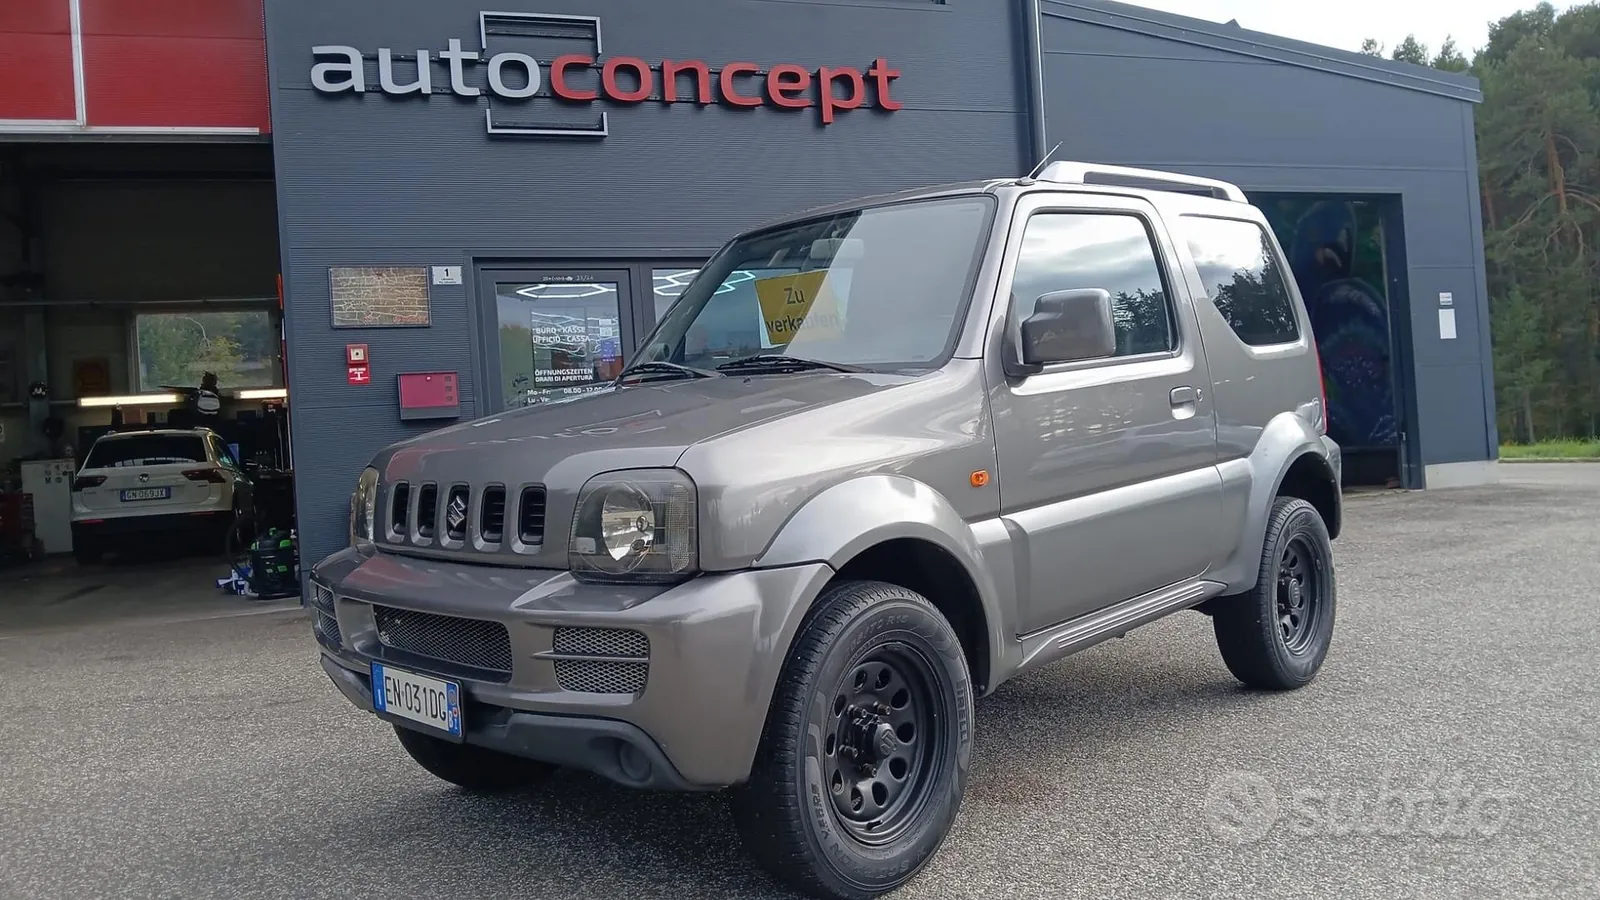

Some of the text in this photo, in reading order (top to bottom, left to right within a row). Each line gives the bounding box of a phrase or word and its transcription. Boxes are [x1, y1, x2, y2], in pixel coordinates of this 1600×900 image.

[310, 38, 901, 124] autoconcept
[443, 268, 449, 277] 1
[784, 287, 805, 304] Zu
